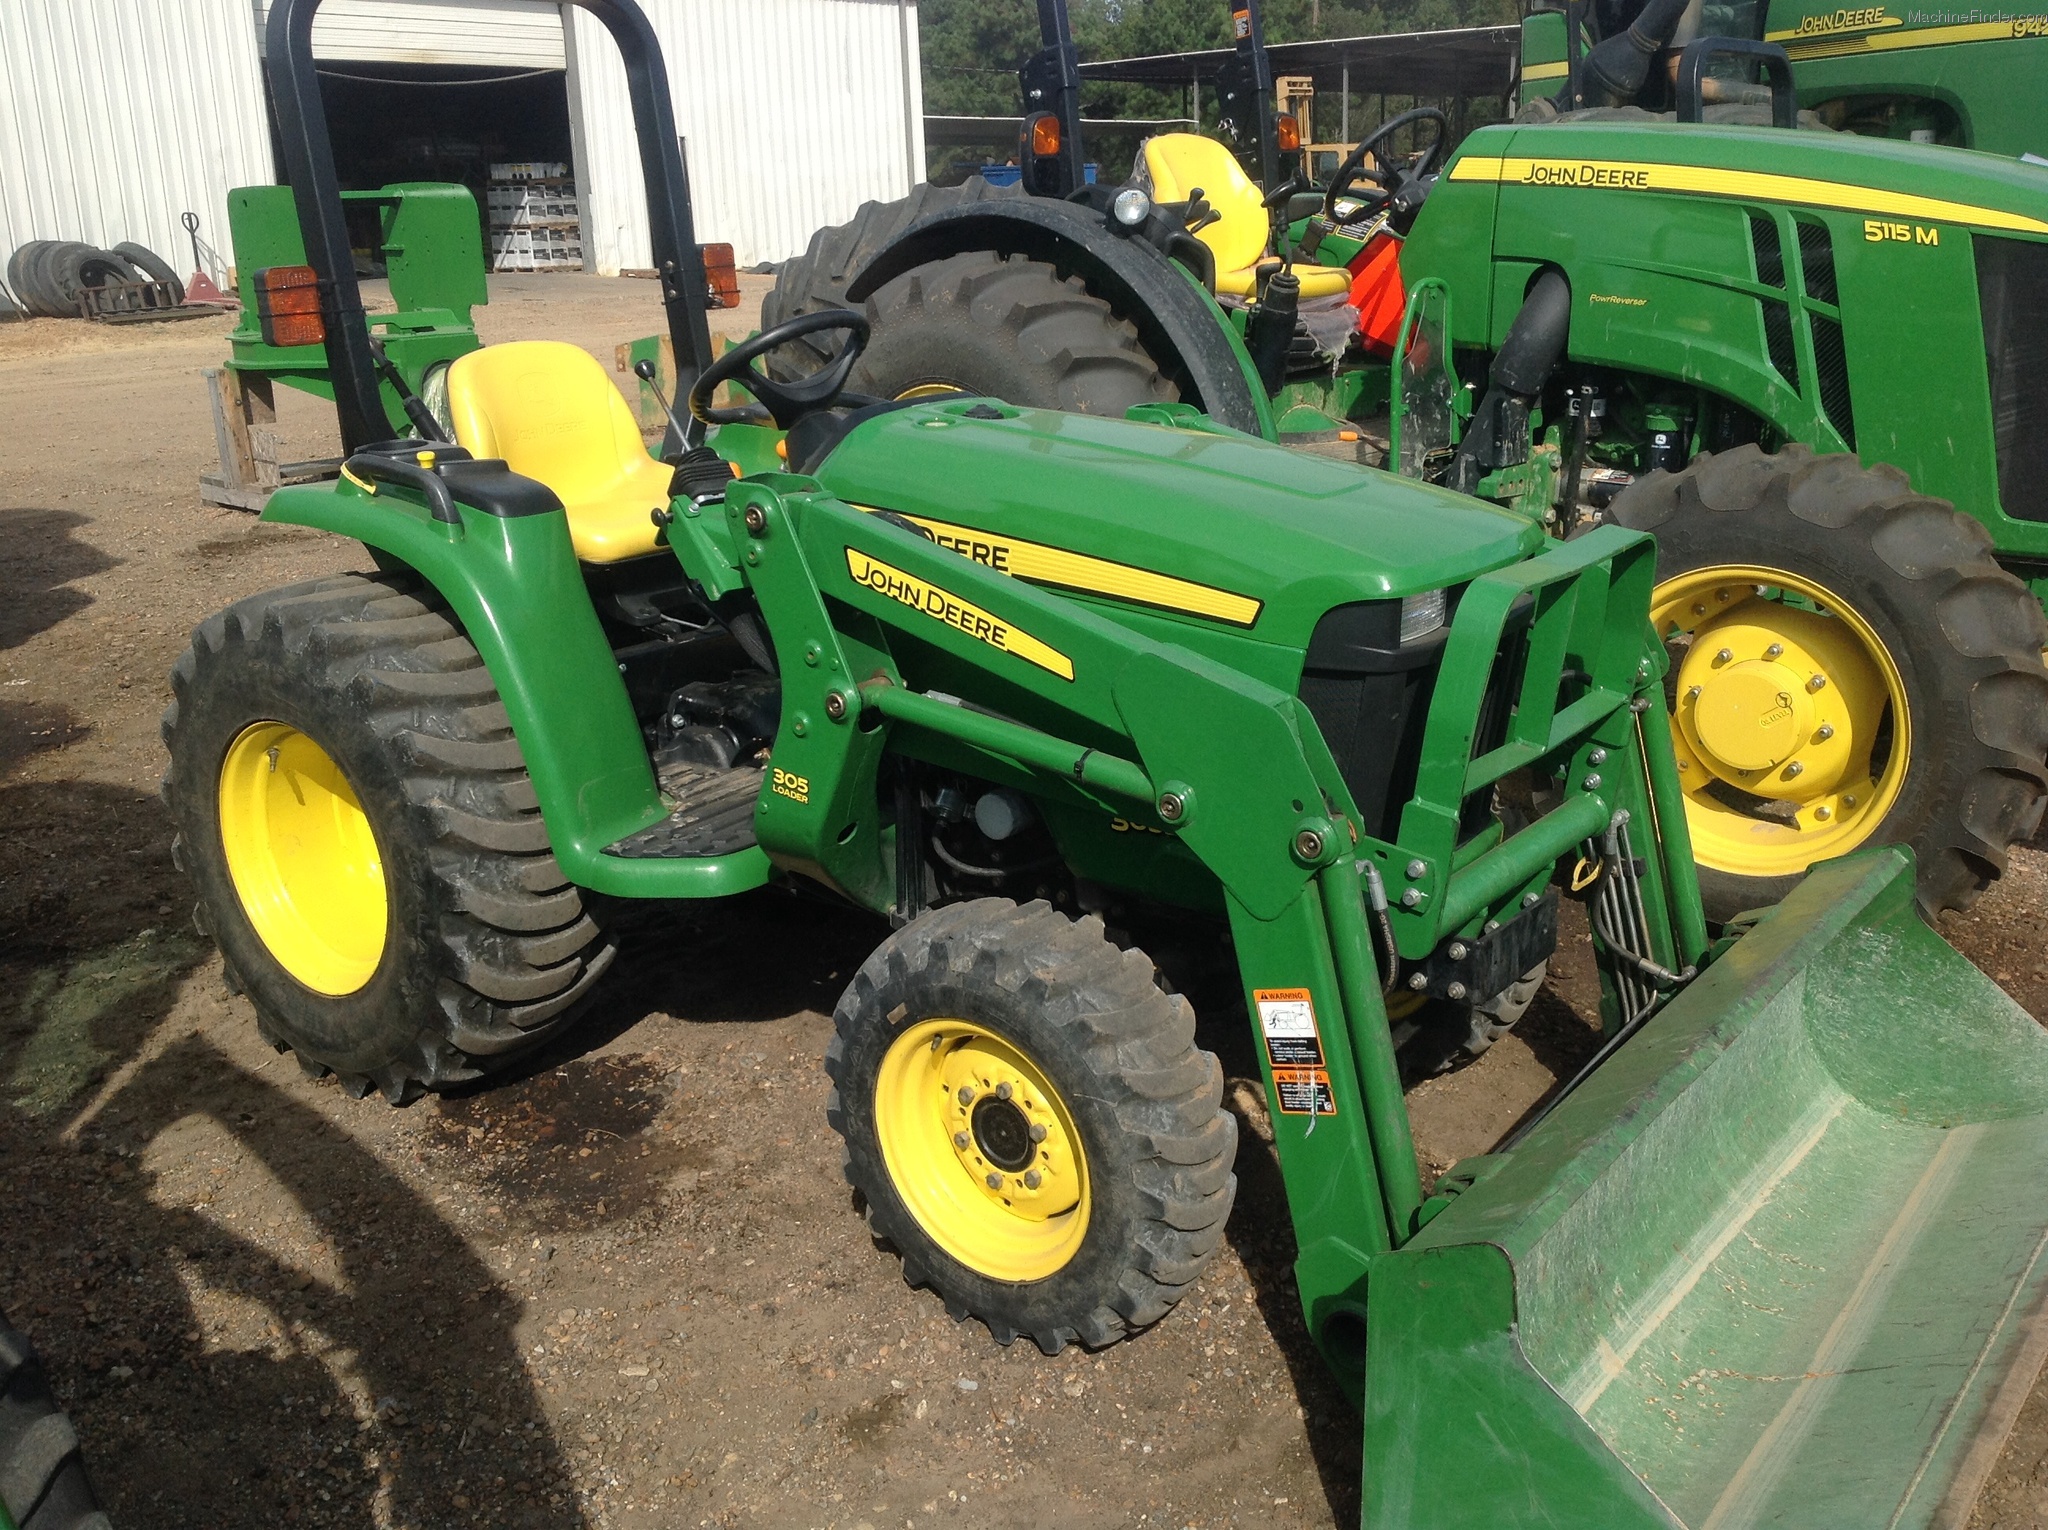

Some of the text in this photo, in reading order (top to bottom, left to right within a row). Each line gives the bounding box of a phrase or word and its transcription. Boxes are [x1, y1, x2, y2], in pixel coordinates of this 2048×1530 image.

[1795, 7, 1885, 34] JOHN DEERE
[1523, 163, 1650, 187] JOHN DEERE
[1863, 219, 1939, 247] 5115 M
[856, 561, 1008, 648] JOHN DEERE
[772, 767, 809, 794] 305
[772, 783, 809, 805] LOADER
[1269, 991, 1304, 1000] WARNING
[1287, 1073, 1323, 1082] WARNNG
